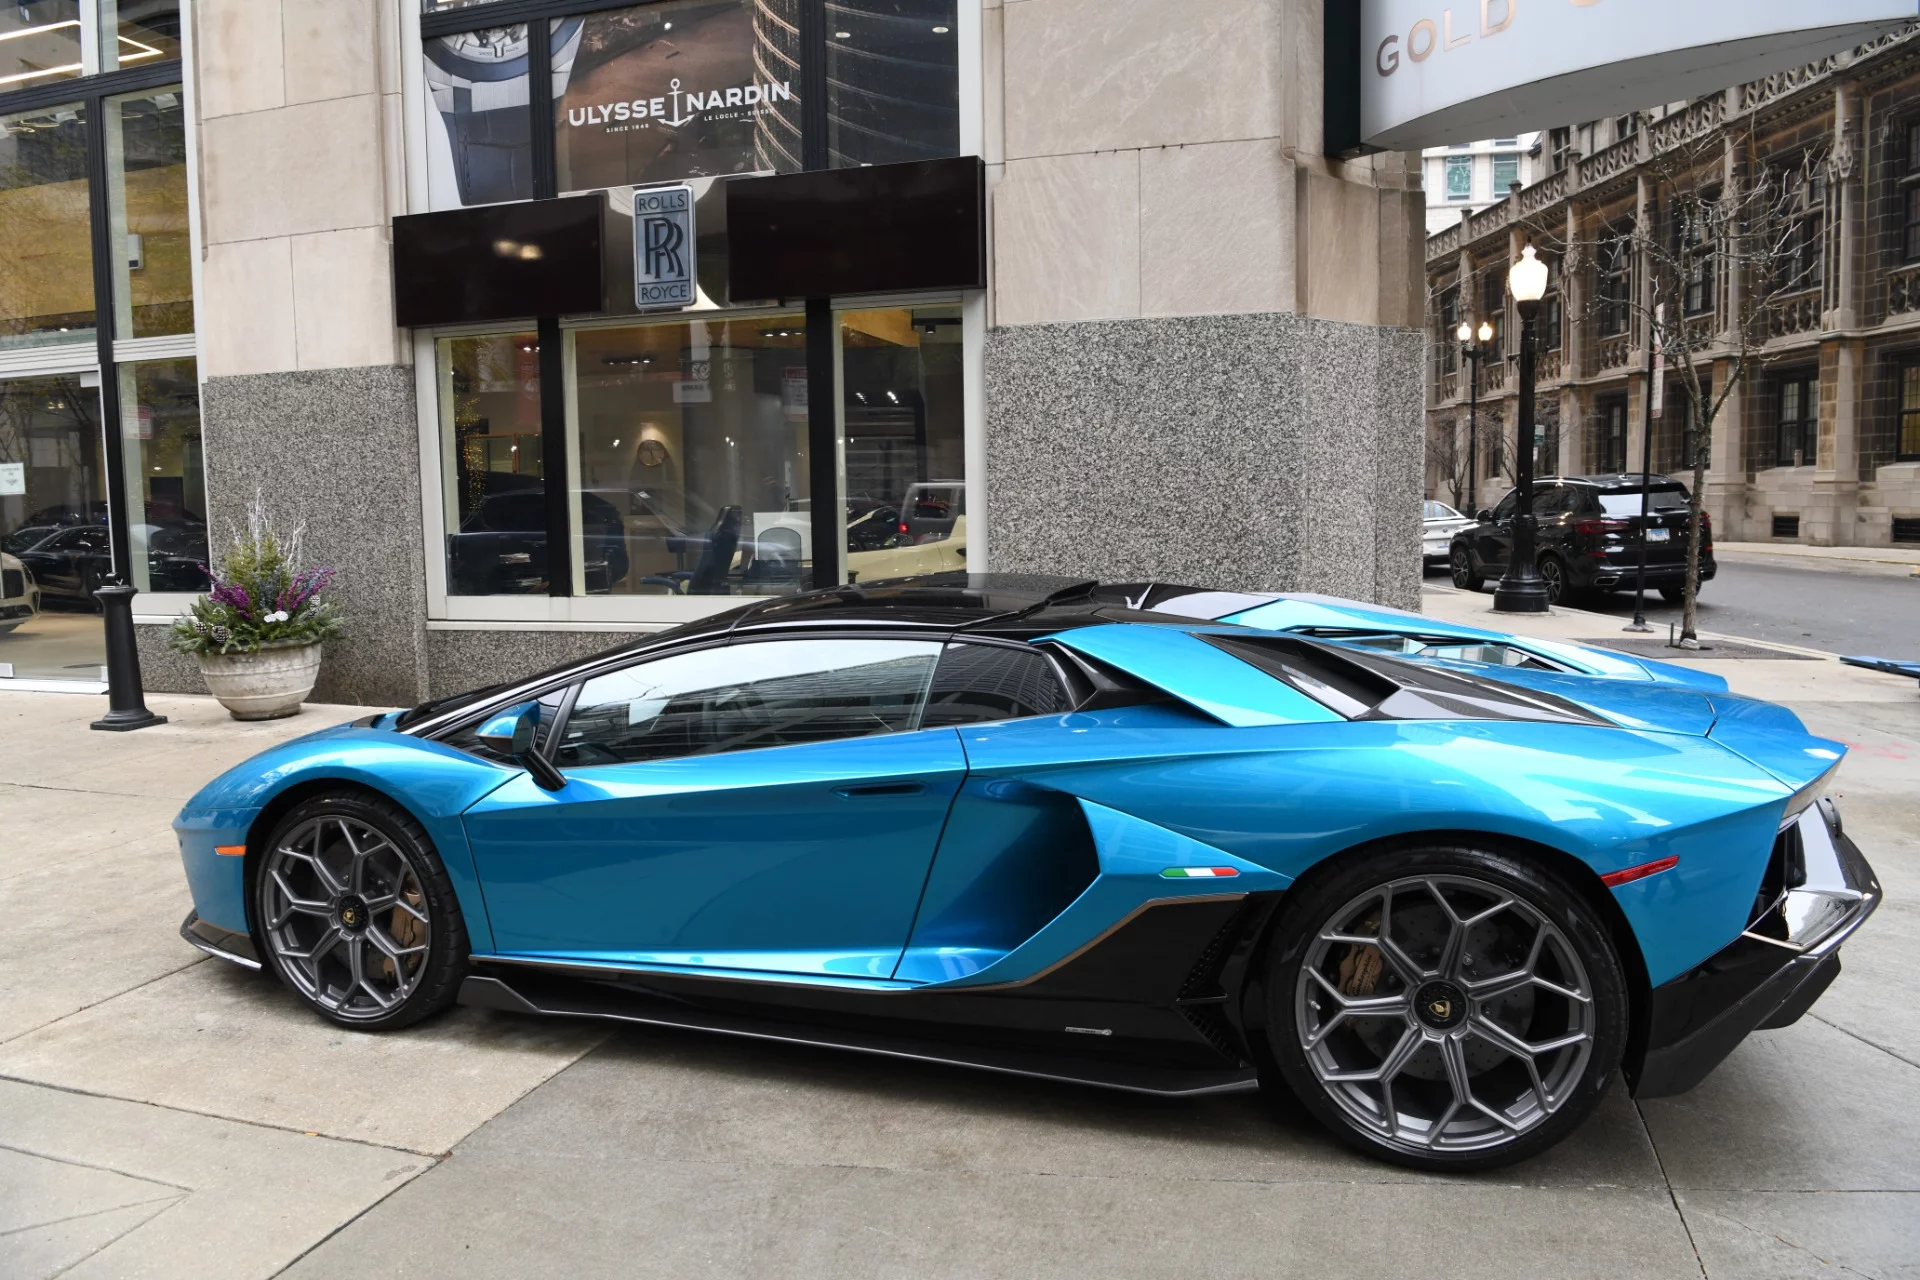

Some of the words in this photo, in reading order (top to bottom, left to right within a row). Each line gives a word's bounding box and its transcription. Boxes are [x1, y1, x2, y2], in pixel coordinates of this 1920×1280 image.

[1376, 0, 1516, 77] GOLD
[568, 97, 665, 127] ULYSSE
[686, 81, 790, 112] NARDIN
[715, 112, 738, 120] LOCLE
[639, 194, 685, 211] ROLLS
[641, 285, 687, 301] ROYCE
